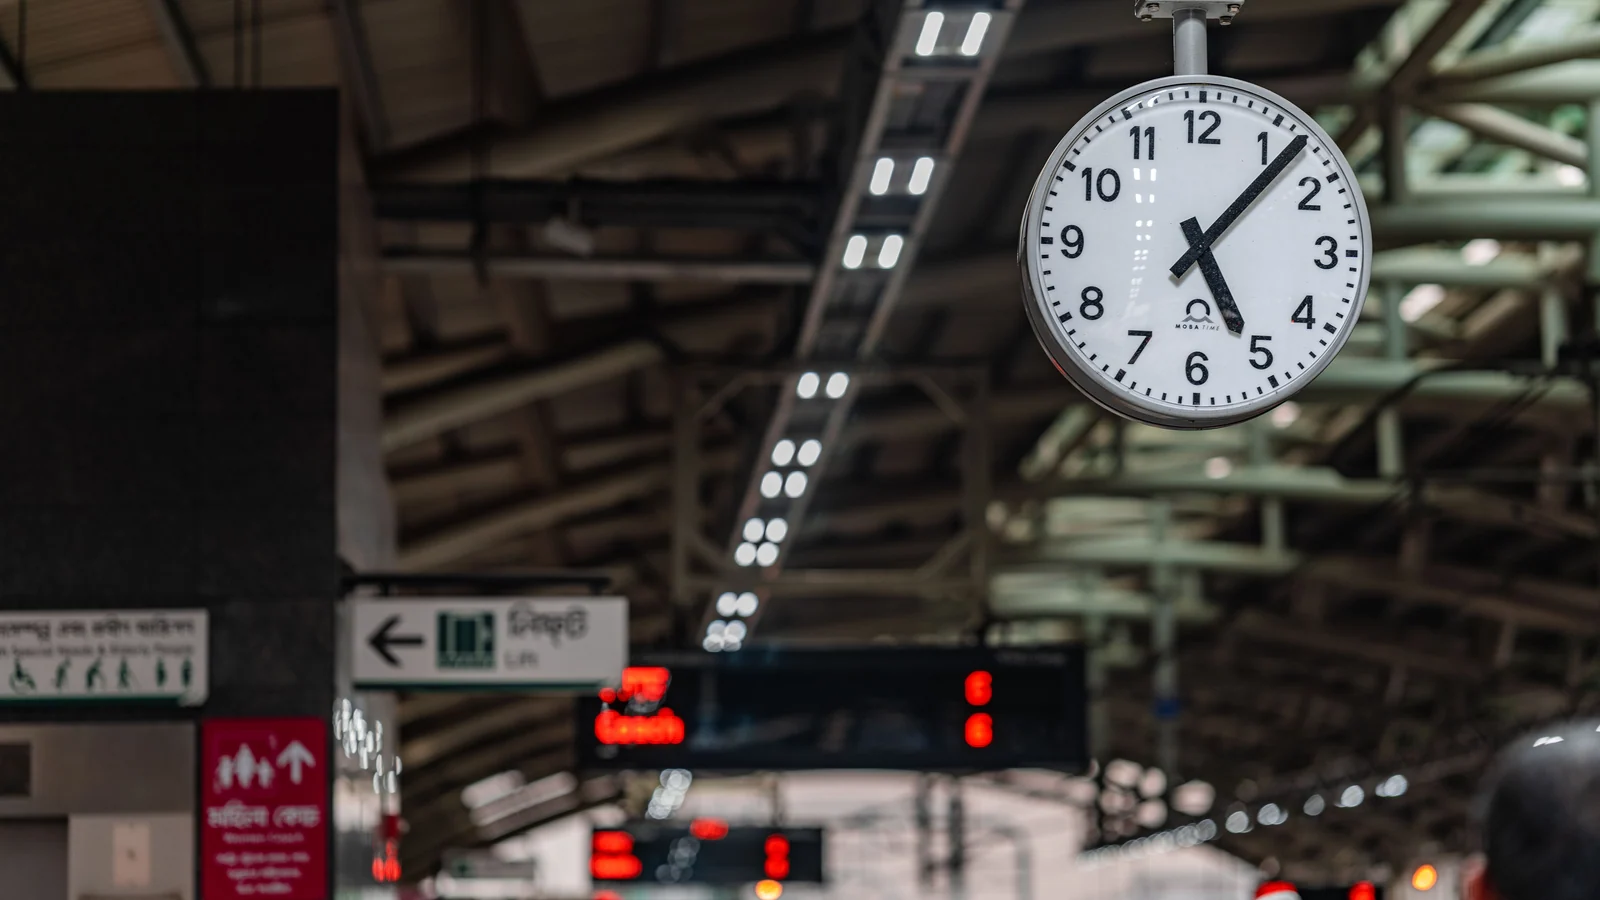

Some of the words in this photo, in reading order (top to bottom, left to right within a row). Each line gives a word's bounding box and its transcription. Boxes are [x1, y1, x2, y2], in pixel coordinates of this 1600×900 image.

[1129, 126, 1155, 161] 11
[1183, 109, 1222, 145] 12
[1257, 131, 1268, 166] 1
[1081, 167, 1121, 203] 10
[1297, 177, 1322, 212] 2
[1060, 224, 1085, 260] 9
[1313, 235, 1339, 270] 3
[1079, 286, 1104, 321] 8
[1291, 295, 1316, 330] 4
[1127, 330, 1153, 365] 7
[1249, 334, 1274, 370] 5
[1185, 351, 1209, 386] 6
